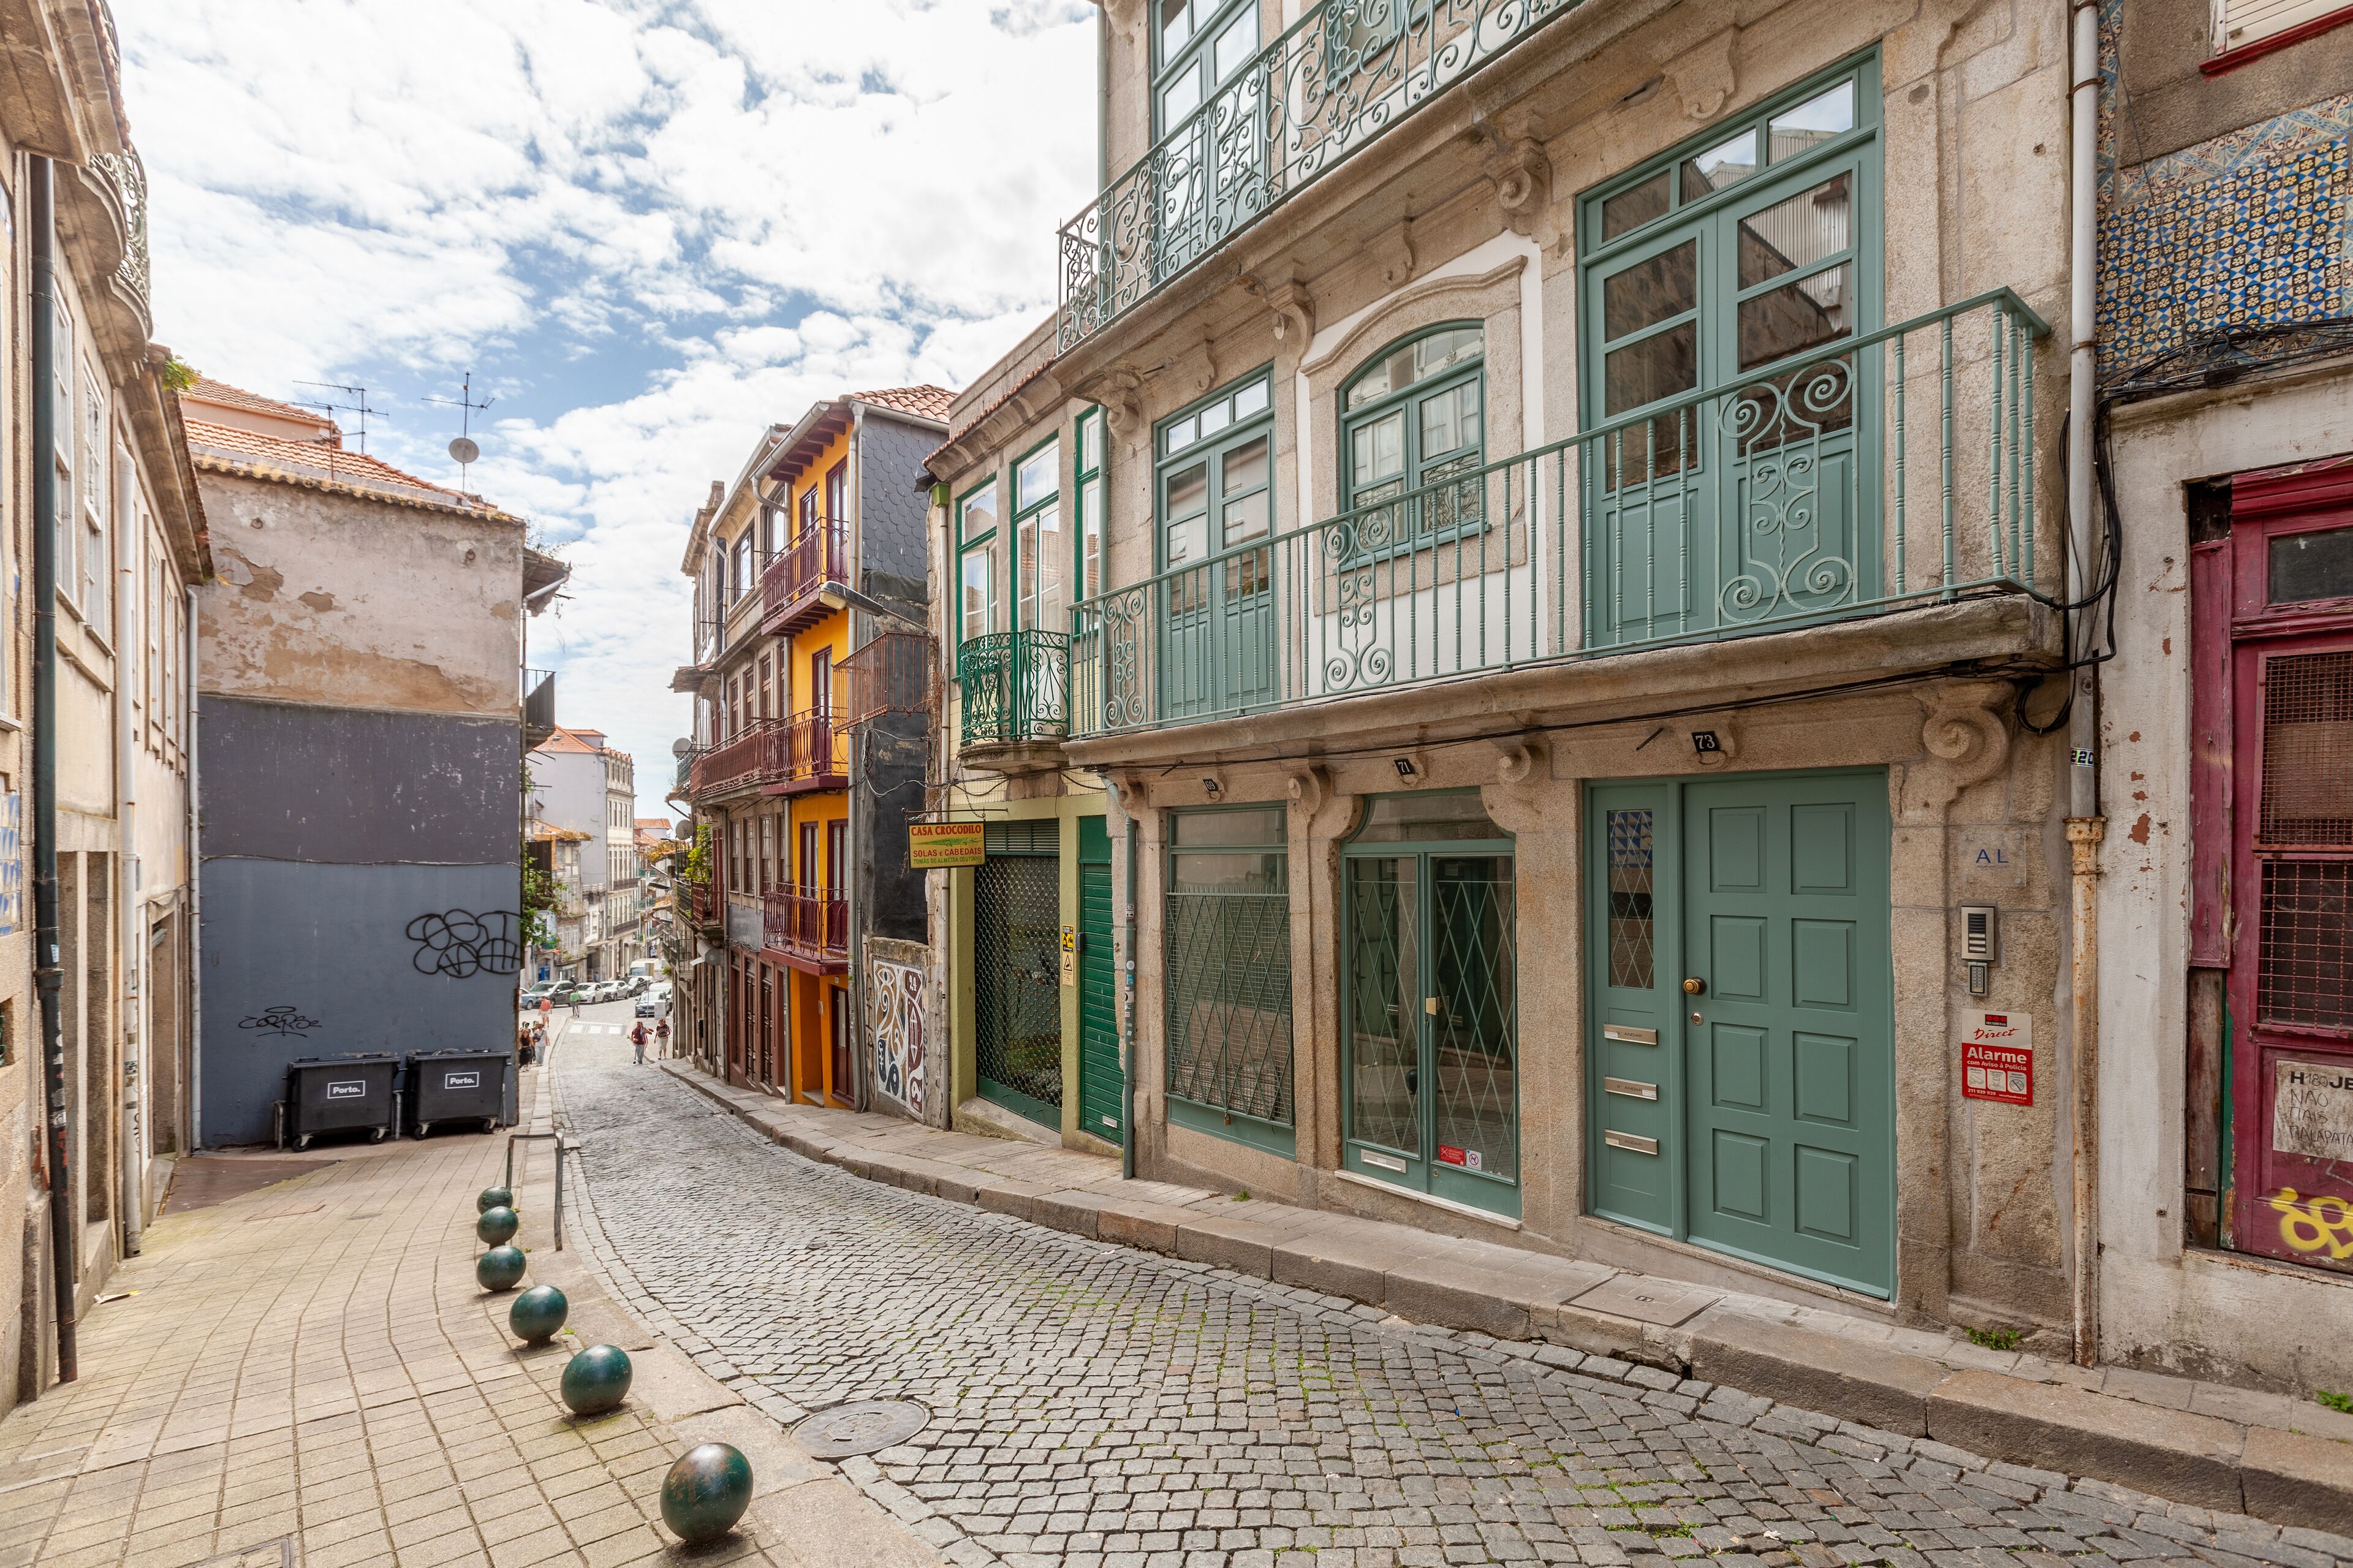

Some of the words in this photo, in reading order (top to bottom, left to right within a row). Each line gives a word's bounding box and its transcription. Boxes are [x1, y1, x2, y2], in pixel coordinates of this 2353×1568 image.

[1695, 734, 1715, 749] 73
[1398, 761, 1411, 773] 71
[1205, 781, 1216, 790] 69
[911, 827, 933, 836] CASA
[935, 825, 981, 835] CROCODILO
[944, 847, 982, 856] CABEDAIS
[1973, 1028, 2021, 1040] Direct
[1967, 1047, 2027, 1064] Alarme
[2290, 1088, 2328, 1107] NÃO
